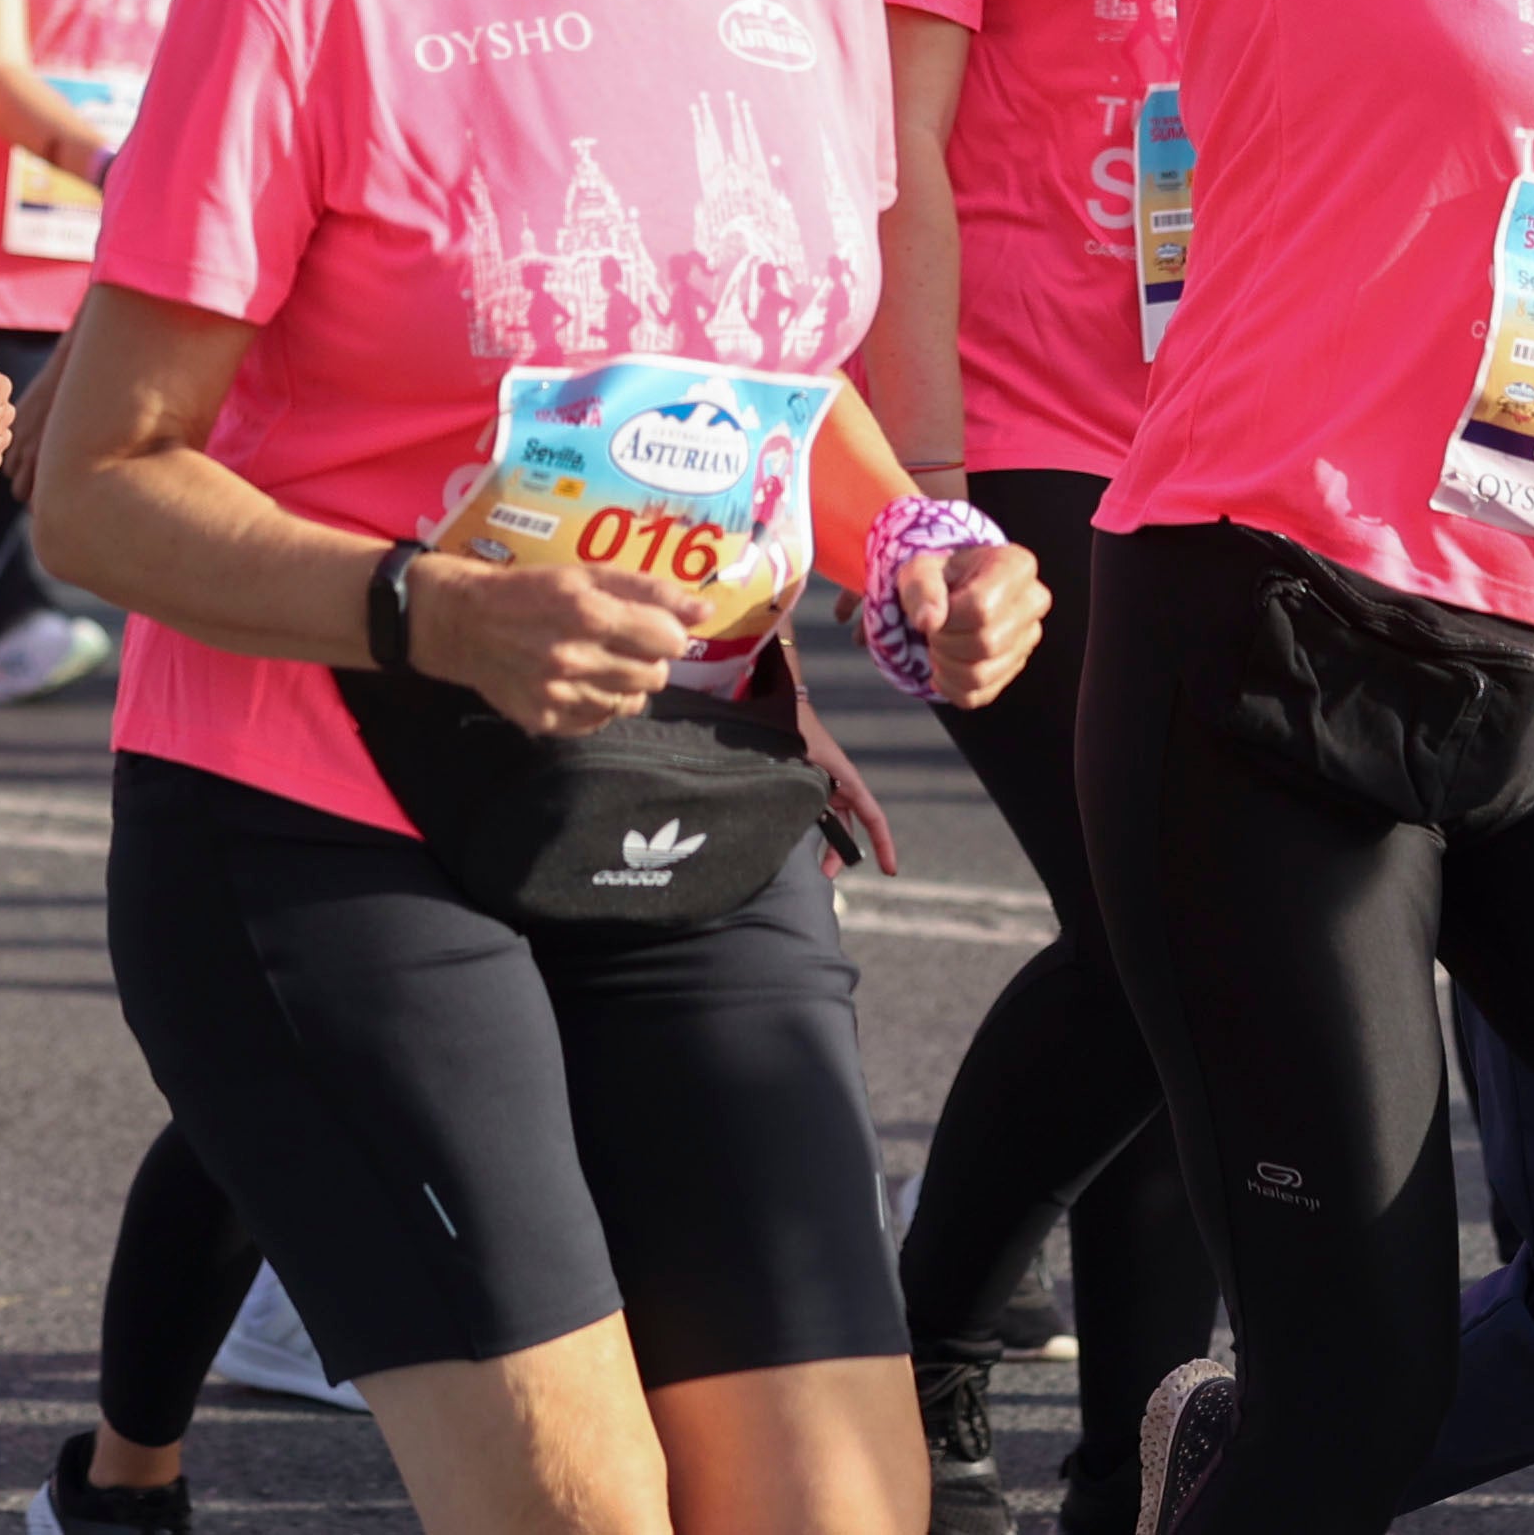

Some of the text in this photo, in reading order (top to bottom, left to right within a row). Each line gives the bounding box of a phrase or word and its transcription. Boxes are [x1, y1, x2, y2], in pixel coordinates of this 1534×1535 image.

[414, 10, 594, 73] OYSHO
[576, 506, 724, 582] 016
[592, 870, 673, 886] adidas
